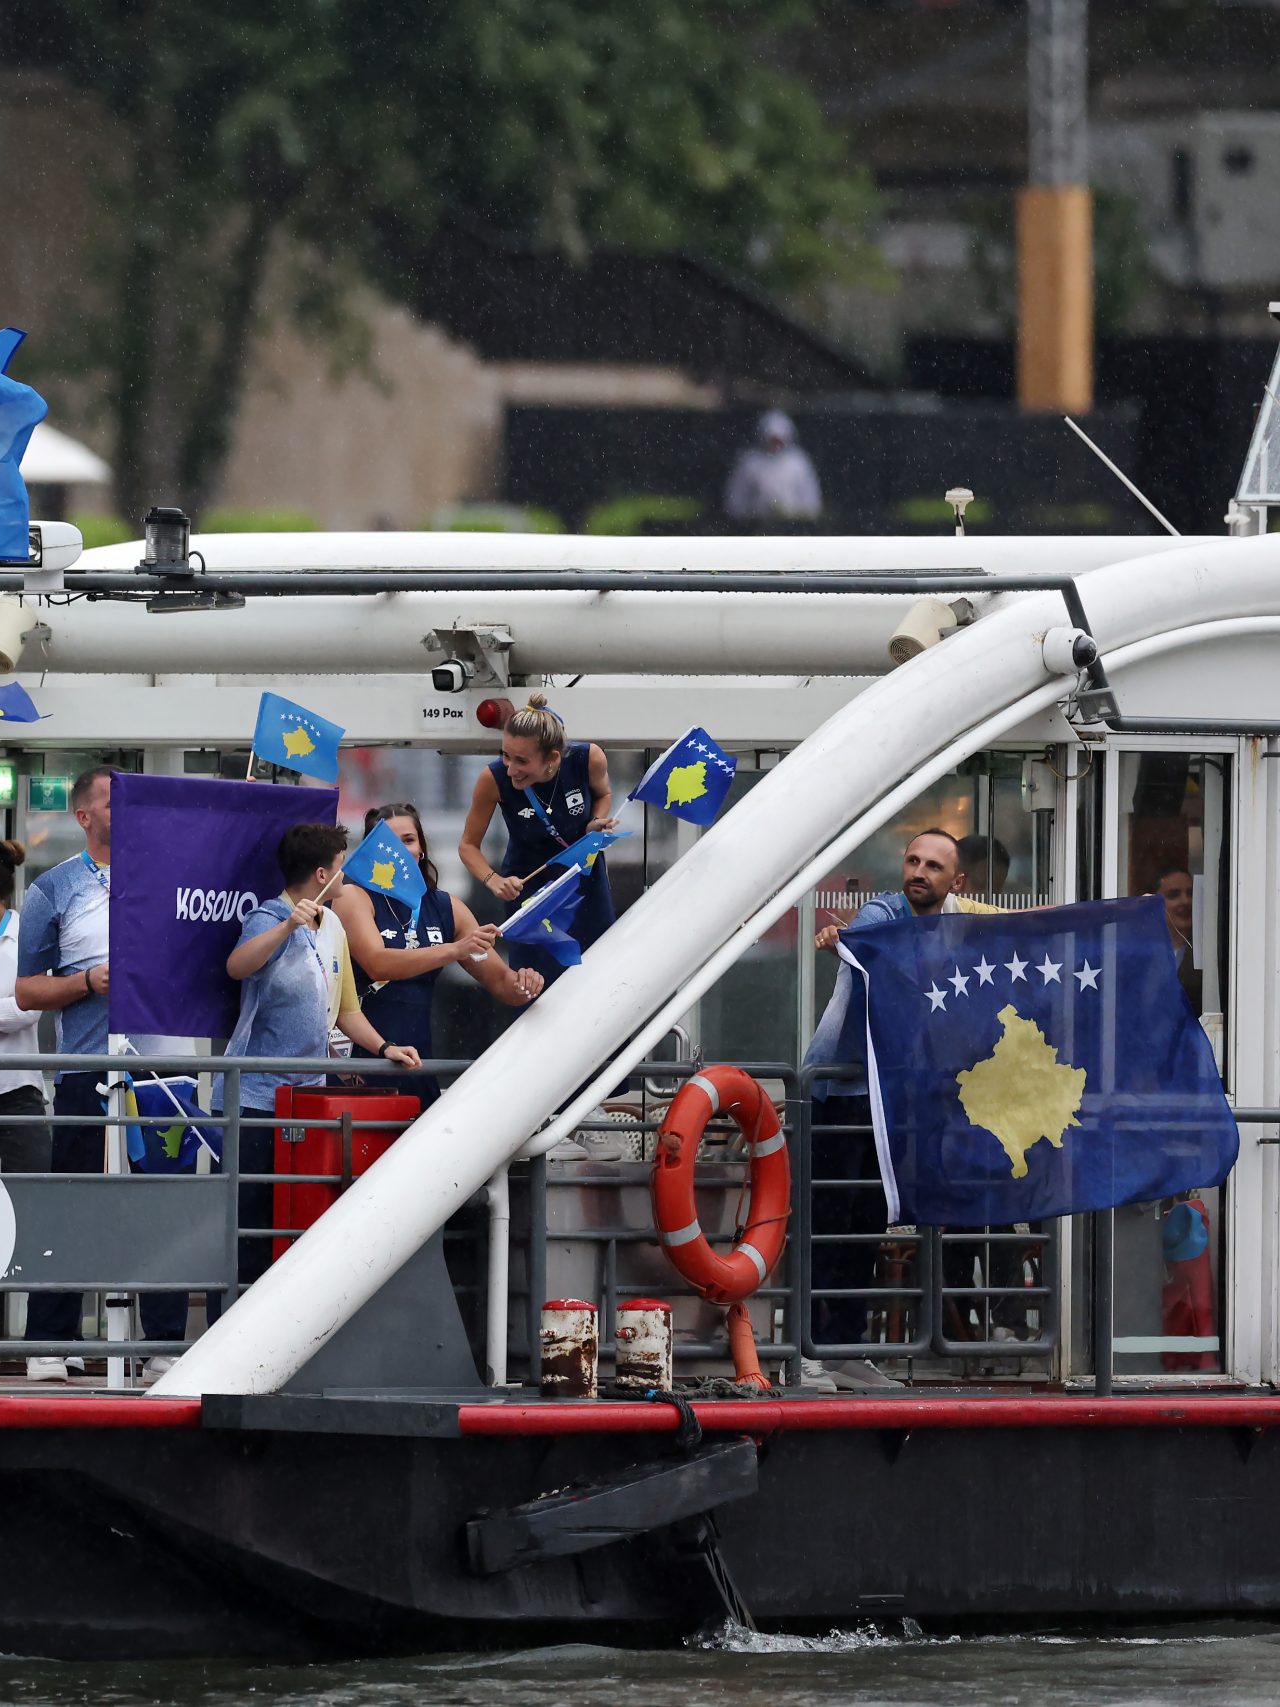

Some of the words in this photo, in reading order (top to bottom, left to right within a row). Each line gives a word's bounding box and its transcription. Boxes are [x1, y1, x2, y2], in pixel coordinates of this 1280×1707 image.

[422, 708, 440, 718] 149
[443, 707, 464, 718] Pax
[517, 807, 536, 819] 4F
[176, 887, 259, 924] KOSOVO
[380, 928, 398, 940] 4F
